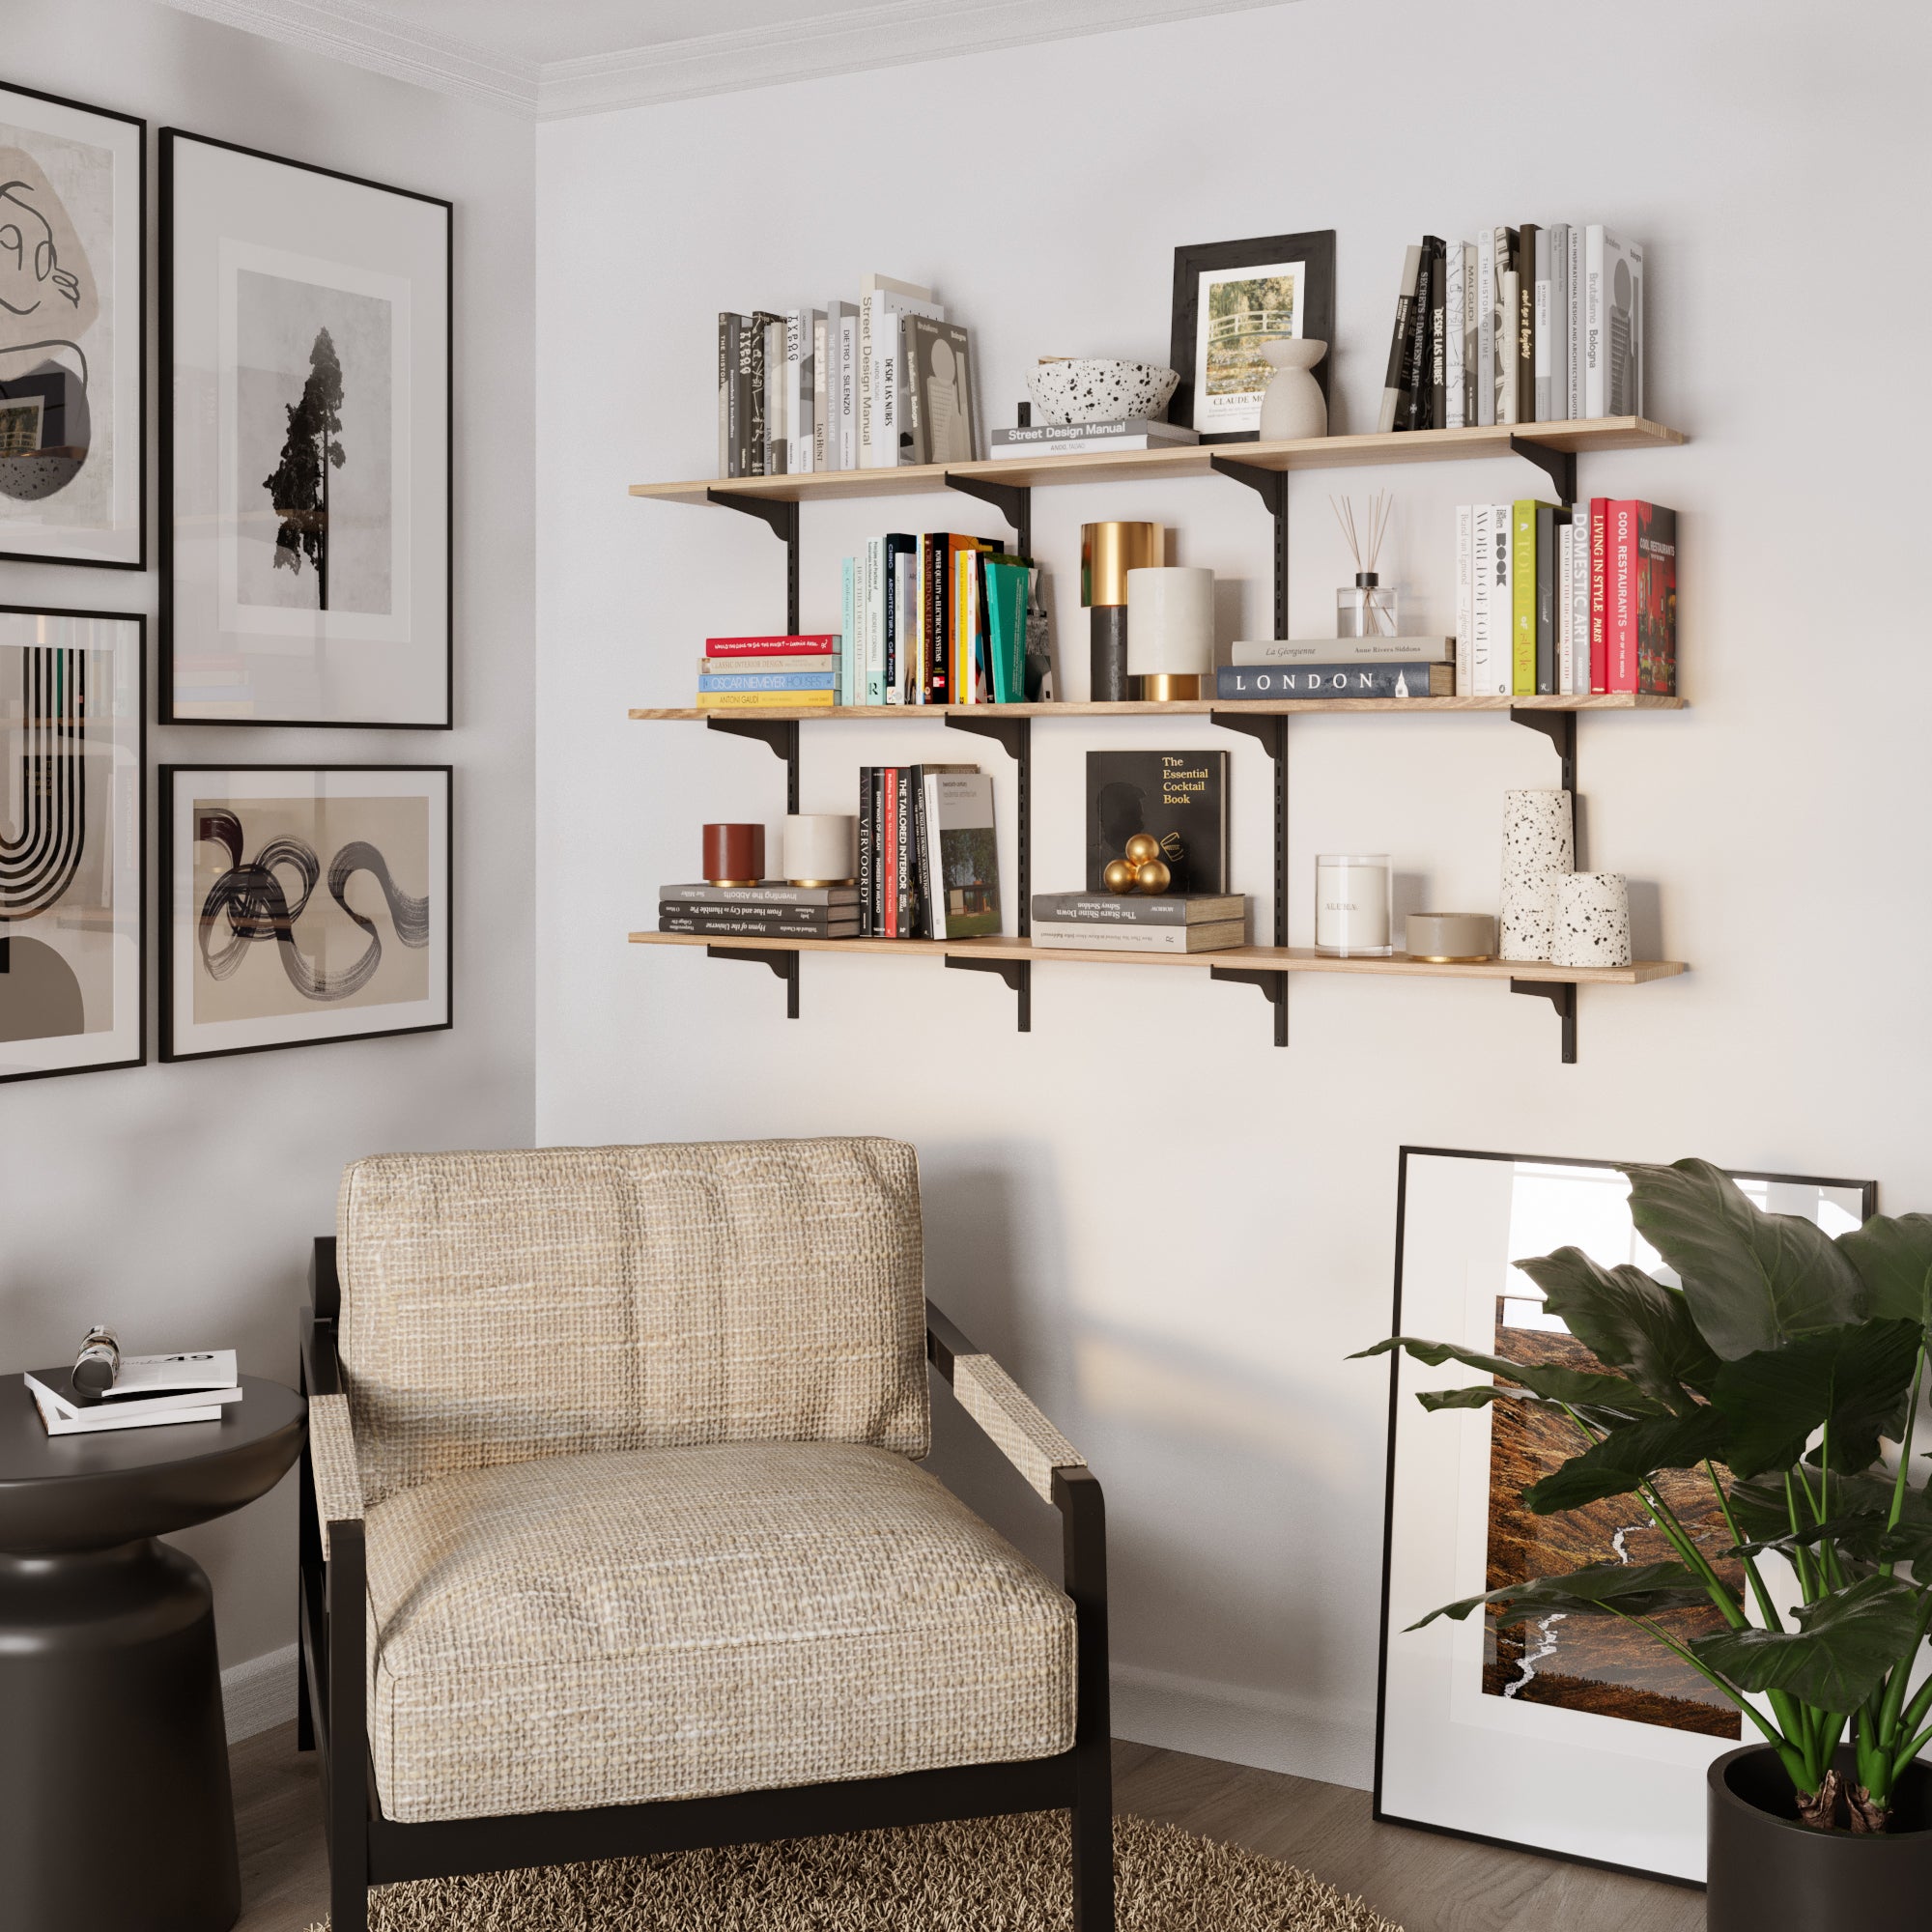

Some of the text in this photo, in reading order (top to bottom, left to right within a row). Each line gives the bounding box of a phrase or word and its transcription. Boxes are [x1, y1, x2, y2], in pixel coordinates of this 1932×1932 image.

[1418, 271, 1428, 314] SECRETS
[1482, 322, 1488, 334] OF
[1587, 272, 1598, 368] Brutalismo Bologna
[1413, 322, 1424, 367] DARKEST
[1520, 328, 1532, 358] begins
[814, 327, 825, 393] STEAM
[862, 297, 872, 446] Street Design Manual
[1411, 368, 1421, 387] ART
[907, 351, 919, 428] Brutalismo Bologna
[1009, 422, 1126, 441] Street Design Manual
[1520, 522, 1529, 531] A
[1618, 511, 1628, 543] COOL
[1496, 532, 1507, 587] BOOK
[1476, 511, 1489, 666] WORLD OF FOLLY
[1574, 513, 1587, 646] DOMESTIC ART
[1593, 515, 1604, 643] LIVING IN STYLE PARIS
[1618, 546, 1628, 627] RESTAURANTS
[1460, 610, 1469, 639] Lighting
[1265, 647, 1316, 658] La Géorgienne
[1460, 640, 1469, 675] Sculptures
[1516, 633, 1531, 671] style
[711, 676, 742, 690] OSCAR
[786, 675, 822, 687] HOUSES
[1236, 672, 1374, 691] LONDON
[720, 696, 740, 704] ANTONI
[1162, 756, 1183, 767] The
[1163, 769, 1208, 779] Essential
[1163, 781, 1206, 791] Cocktail
[1163, 794, 1190, 804] Book
[875, 824, 881, 833] OF
[861, 818, 869, 905] VERVOORDT
[724, 891, 797, 900] Inventing the Abbotts
[875, 883, 881, 892] DI
[730, 905, 741, 915] Cry
[1122, 911, 1137, 920] The
[741, 923, 748, 931] of
